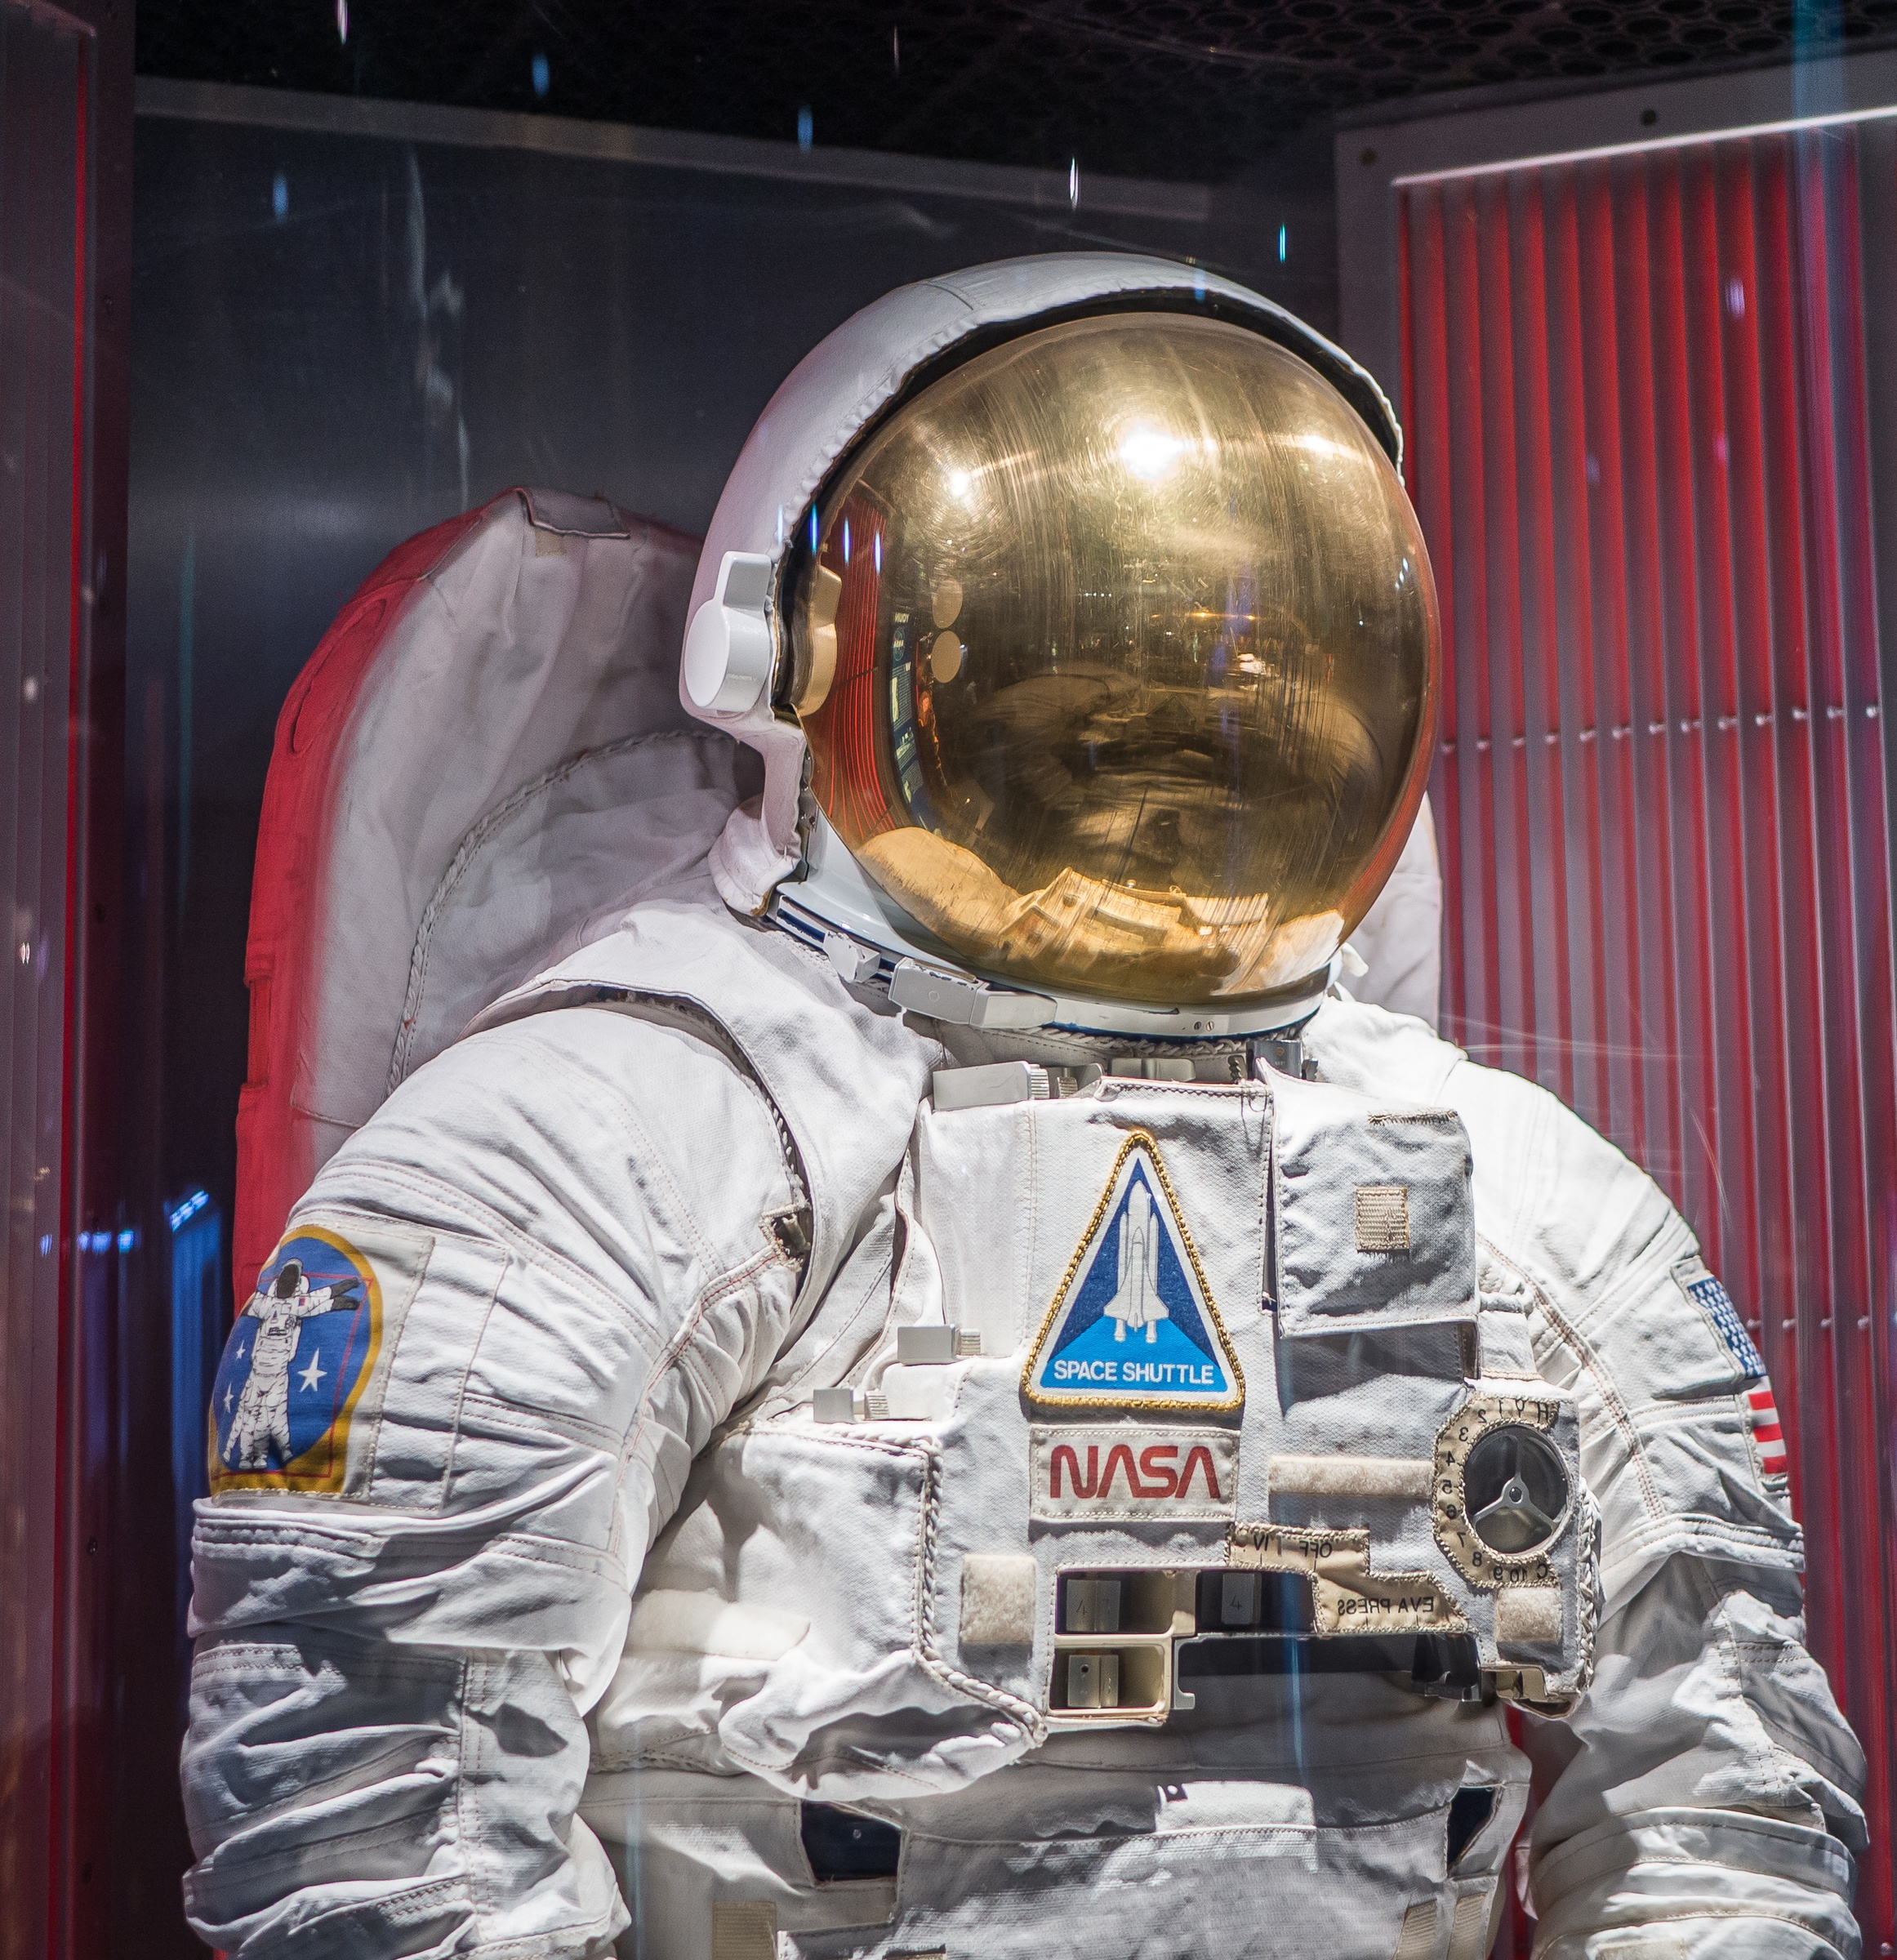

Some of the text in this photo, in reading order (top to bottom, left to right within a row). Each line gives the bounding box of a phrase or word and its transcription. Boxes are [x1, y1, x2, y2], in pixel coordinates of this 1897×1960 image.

[1053, 1360, 1214, 1384] SPACE SHUTTLE
[1049, 1443, 1222, 1499] NASA
[1231, 1594, 1243, 1612] 4
